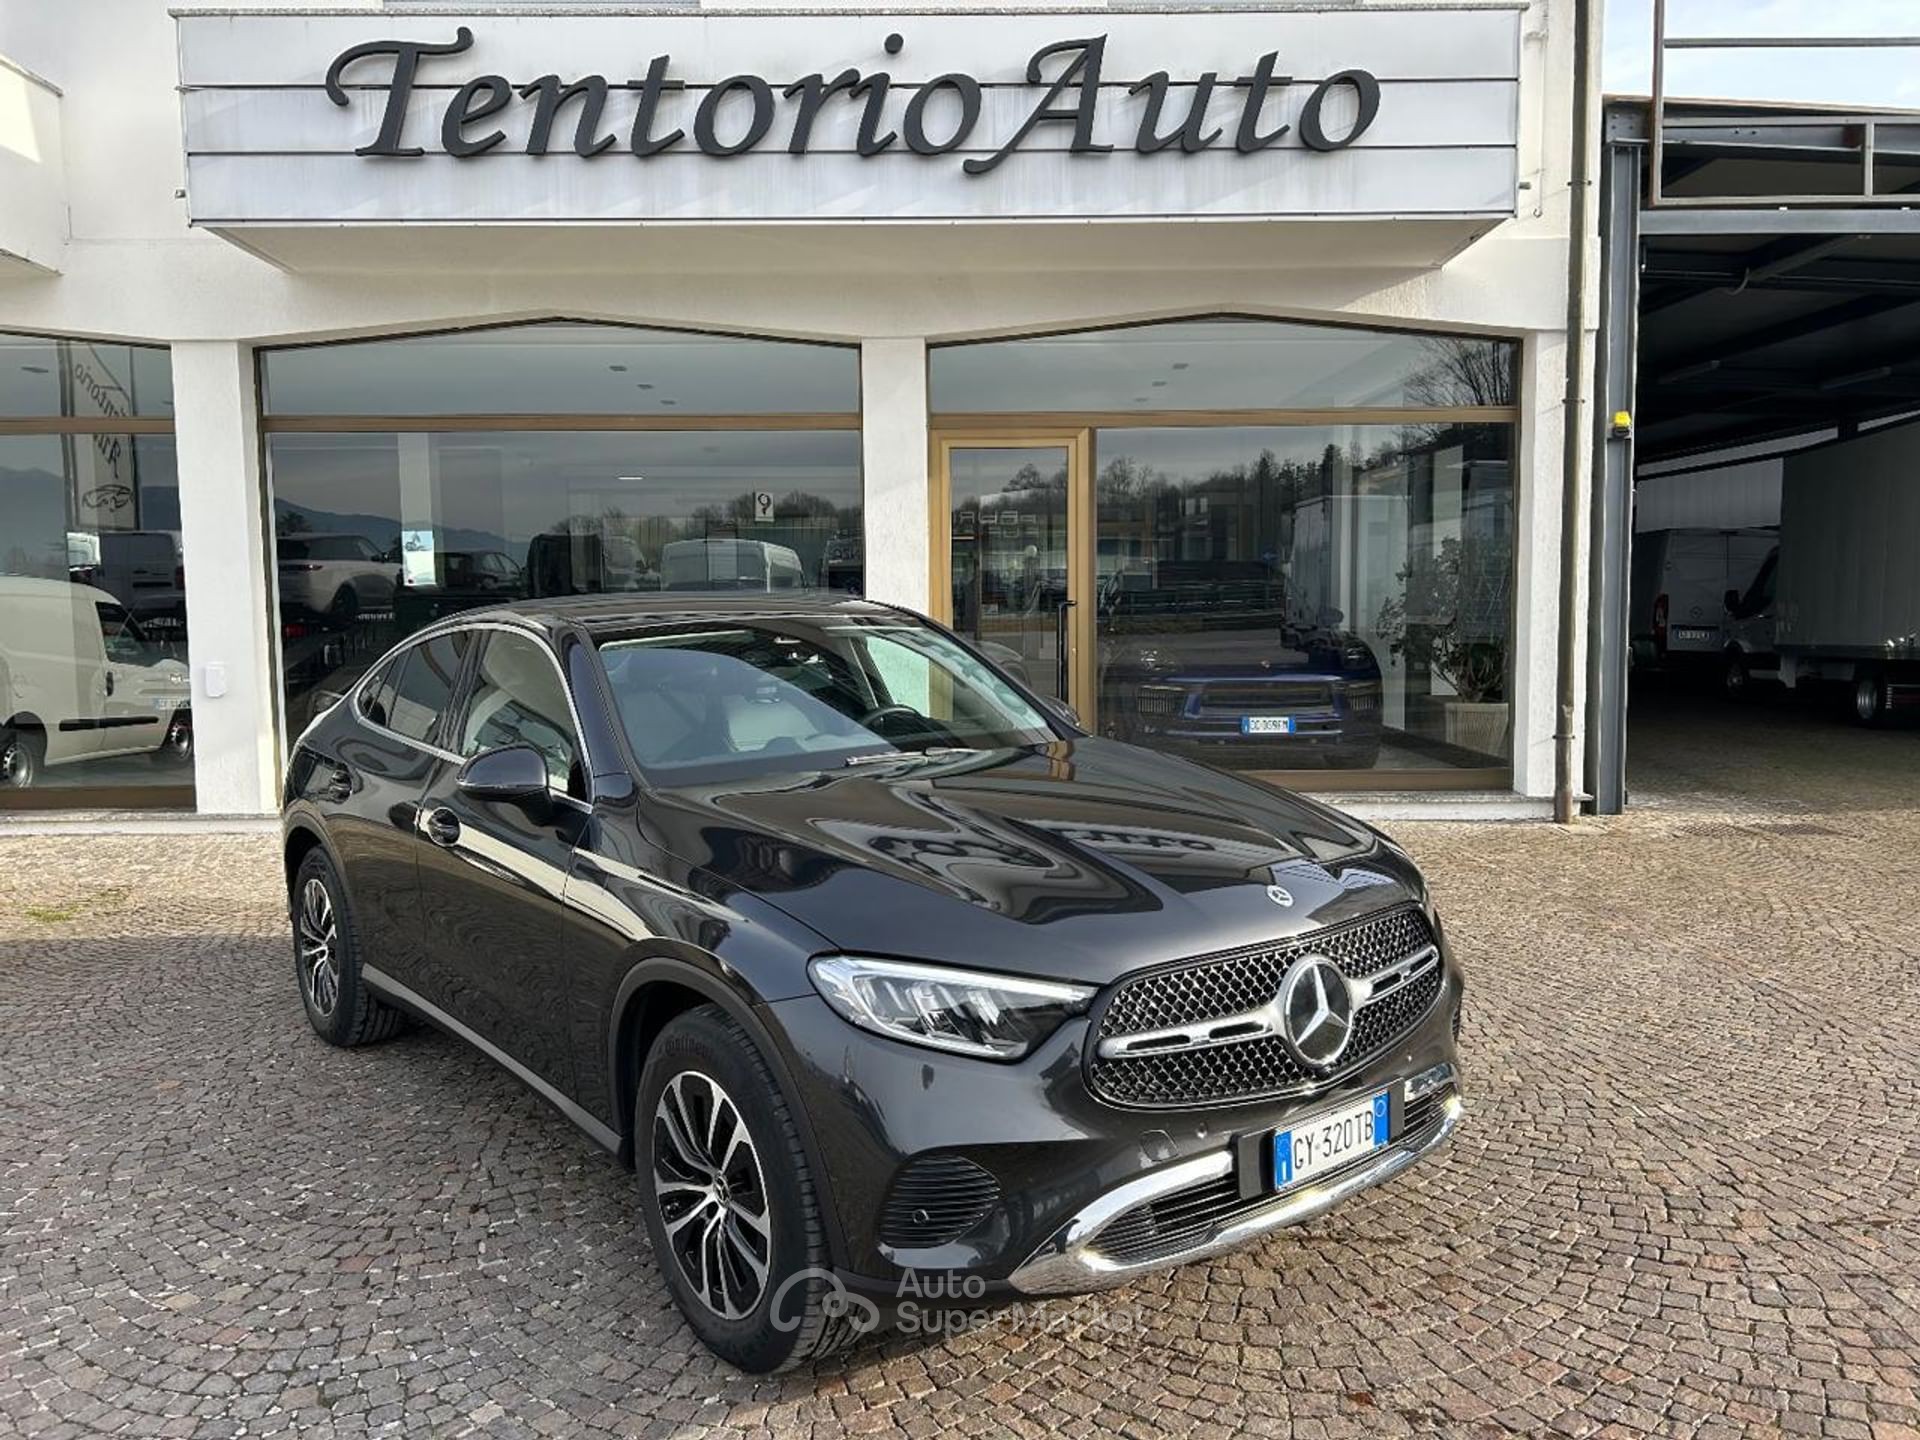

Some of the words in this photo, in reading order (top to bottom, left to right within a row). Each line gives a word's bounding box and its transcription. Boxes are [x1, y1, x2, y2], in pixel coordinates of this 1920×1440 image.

[325, 26, 981, 157] Tentorio
[963, 33, 1381, 175] Auto
[1322, 1111, 1374, 1158] 320TB
